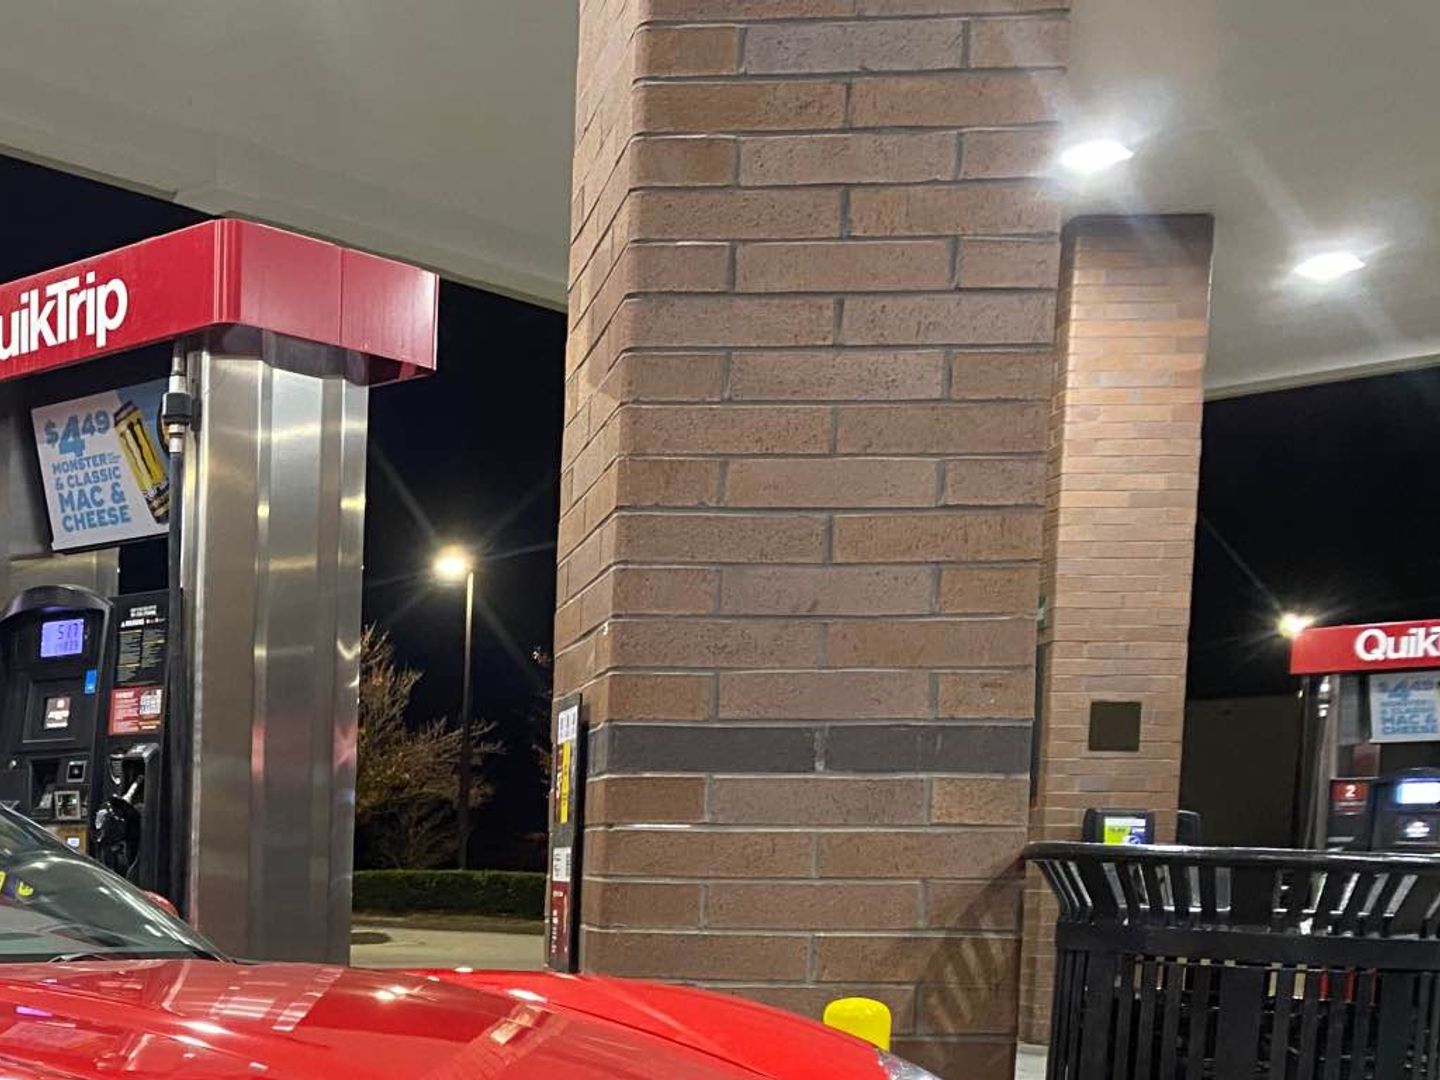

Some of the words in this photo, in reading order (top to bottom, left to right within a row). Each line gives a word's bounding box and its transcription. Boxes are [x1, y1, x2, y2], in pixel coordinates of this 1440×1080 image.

[51, 455, 107, 475] MONSTER
[66, 466, 122, 488] CLASSIC
[57, 485, 103, 514] MAC
[110, 482, 126, 504] &
[62, 505, 131, 533] CHEESE
[1354, 626, 1440, 661] Quik
[1345, 784, 1357, 798] 2
